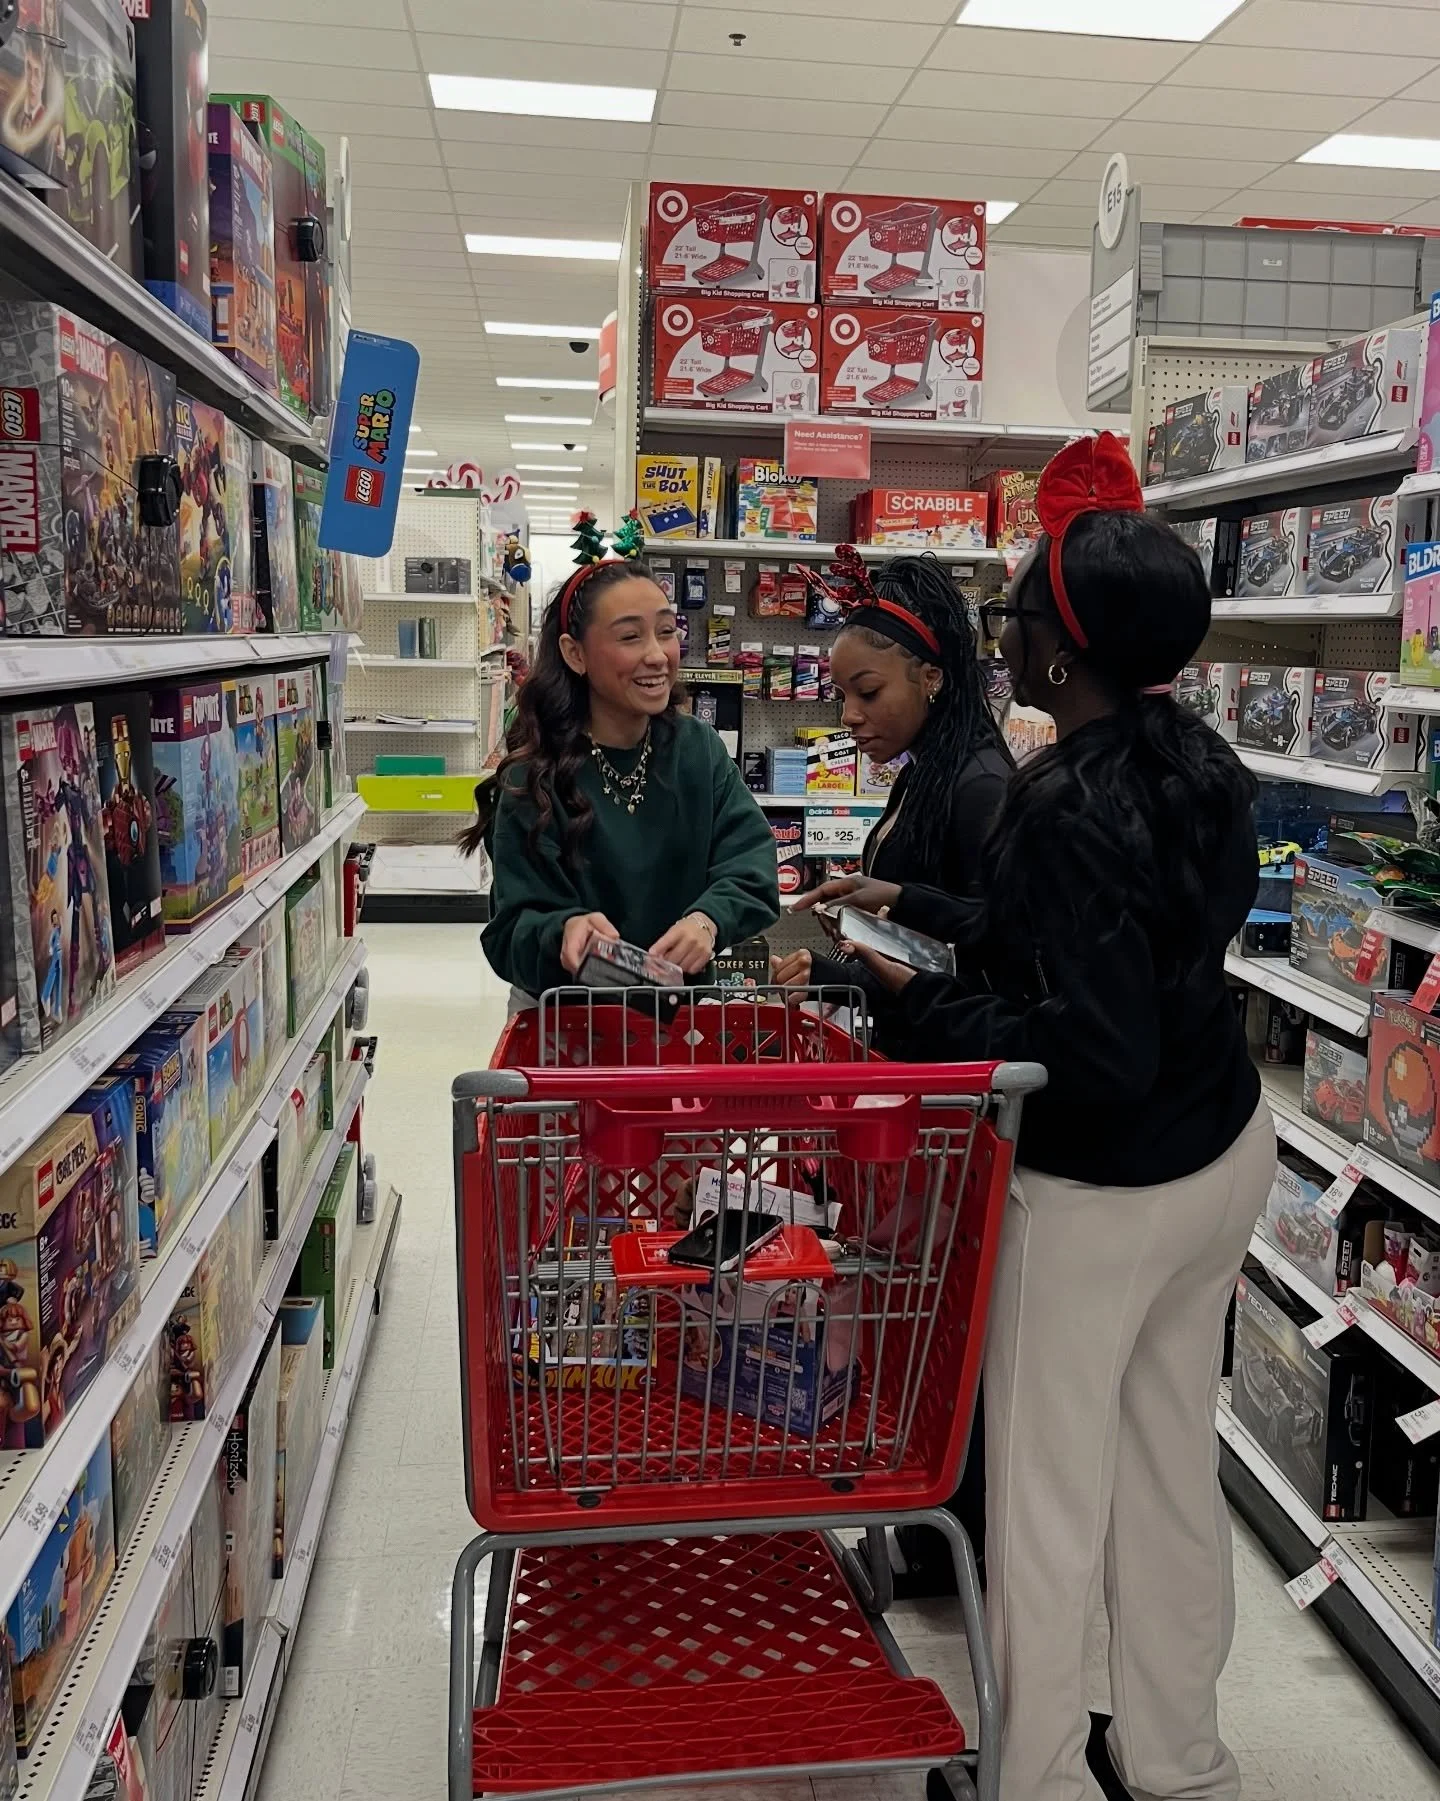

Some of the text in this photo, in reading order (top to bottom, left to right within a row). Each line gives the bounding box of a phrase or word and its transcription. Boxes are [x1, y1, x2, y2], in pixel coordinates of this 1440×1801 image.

[1107, 181, 1123, 214] E15
[701, 289, 711, 297] Big
[873, 299, 883, 307] Big
[894, 300, 921, 308] Shopping
[1322, 353, 1348, 369] SPEED
[1, 388, 25, 438] LEGO
[705, 402, 715, 410] Big
[728, 403, 755, 411] Shopping
[871, 409, 881, 417] Big
[893, 410, 919, 419] Shopping
[353, 392, 374, 451] SUPER
[366, 388, 396, 464] MARIO
[794, 430, 864, 441] Need Assistance?
[645, 465, 687, 479] SHUT
[1001, 471, 1024, 487] UNO
[356, 468, 374, 505] LEGO
[643, 480, 691, 493] THE BOX
[1003, 480, 1036, 502] ATTACK
[0, 451, 37, 552] MARVEL
[891, 495, 973, 513] SCRABBLE
[1323, 508, 1351, 521] SPEED
[1250, 520, 1269, 532] SPEED
[1183, 667, 1199, 678] SPEED
[1250, 672, 1271, 683] SPEED
[1326, 678, 1350, 690] SPEED
[833, 732, 849, 740] TACO
[830, 758, 850, 766] CHEESE
[807, 831, 824, 841] $10
[834, 831, 854, 841] $25
[1307, 867, 1339, 889] SPEED
[713, 959, 765, 970] POKER SET
[162, 1056, 180, 1084] SONIC
[136, 1095, 147, 1134] SONIC
[1340, 1239, 1350, 1277] SPEED
[1246, 1292, 1278, 1328] TECHNIC
[230, 1432, 243, 1491] HORIZON
[1331, 1464, 1339, 1502] TECHNIC
[28, 1502, 49, 1533] 34.99
[157, 1544, 173, 1569] 22.99
[243, 1714, 258, 1733] 44.99
